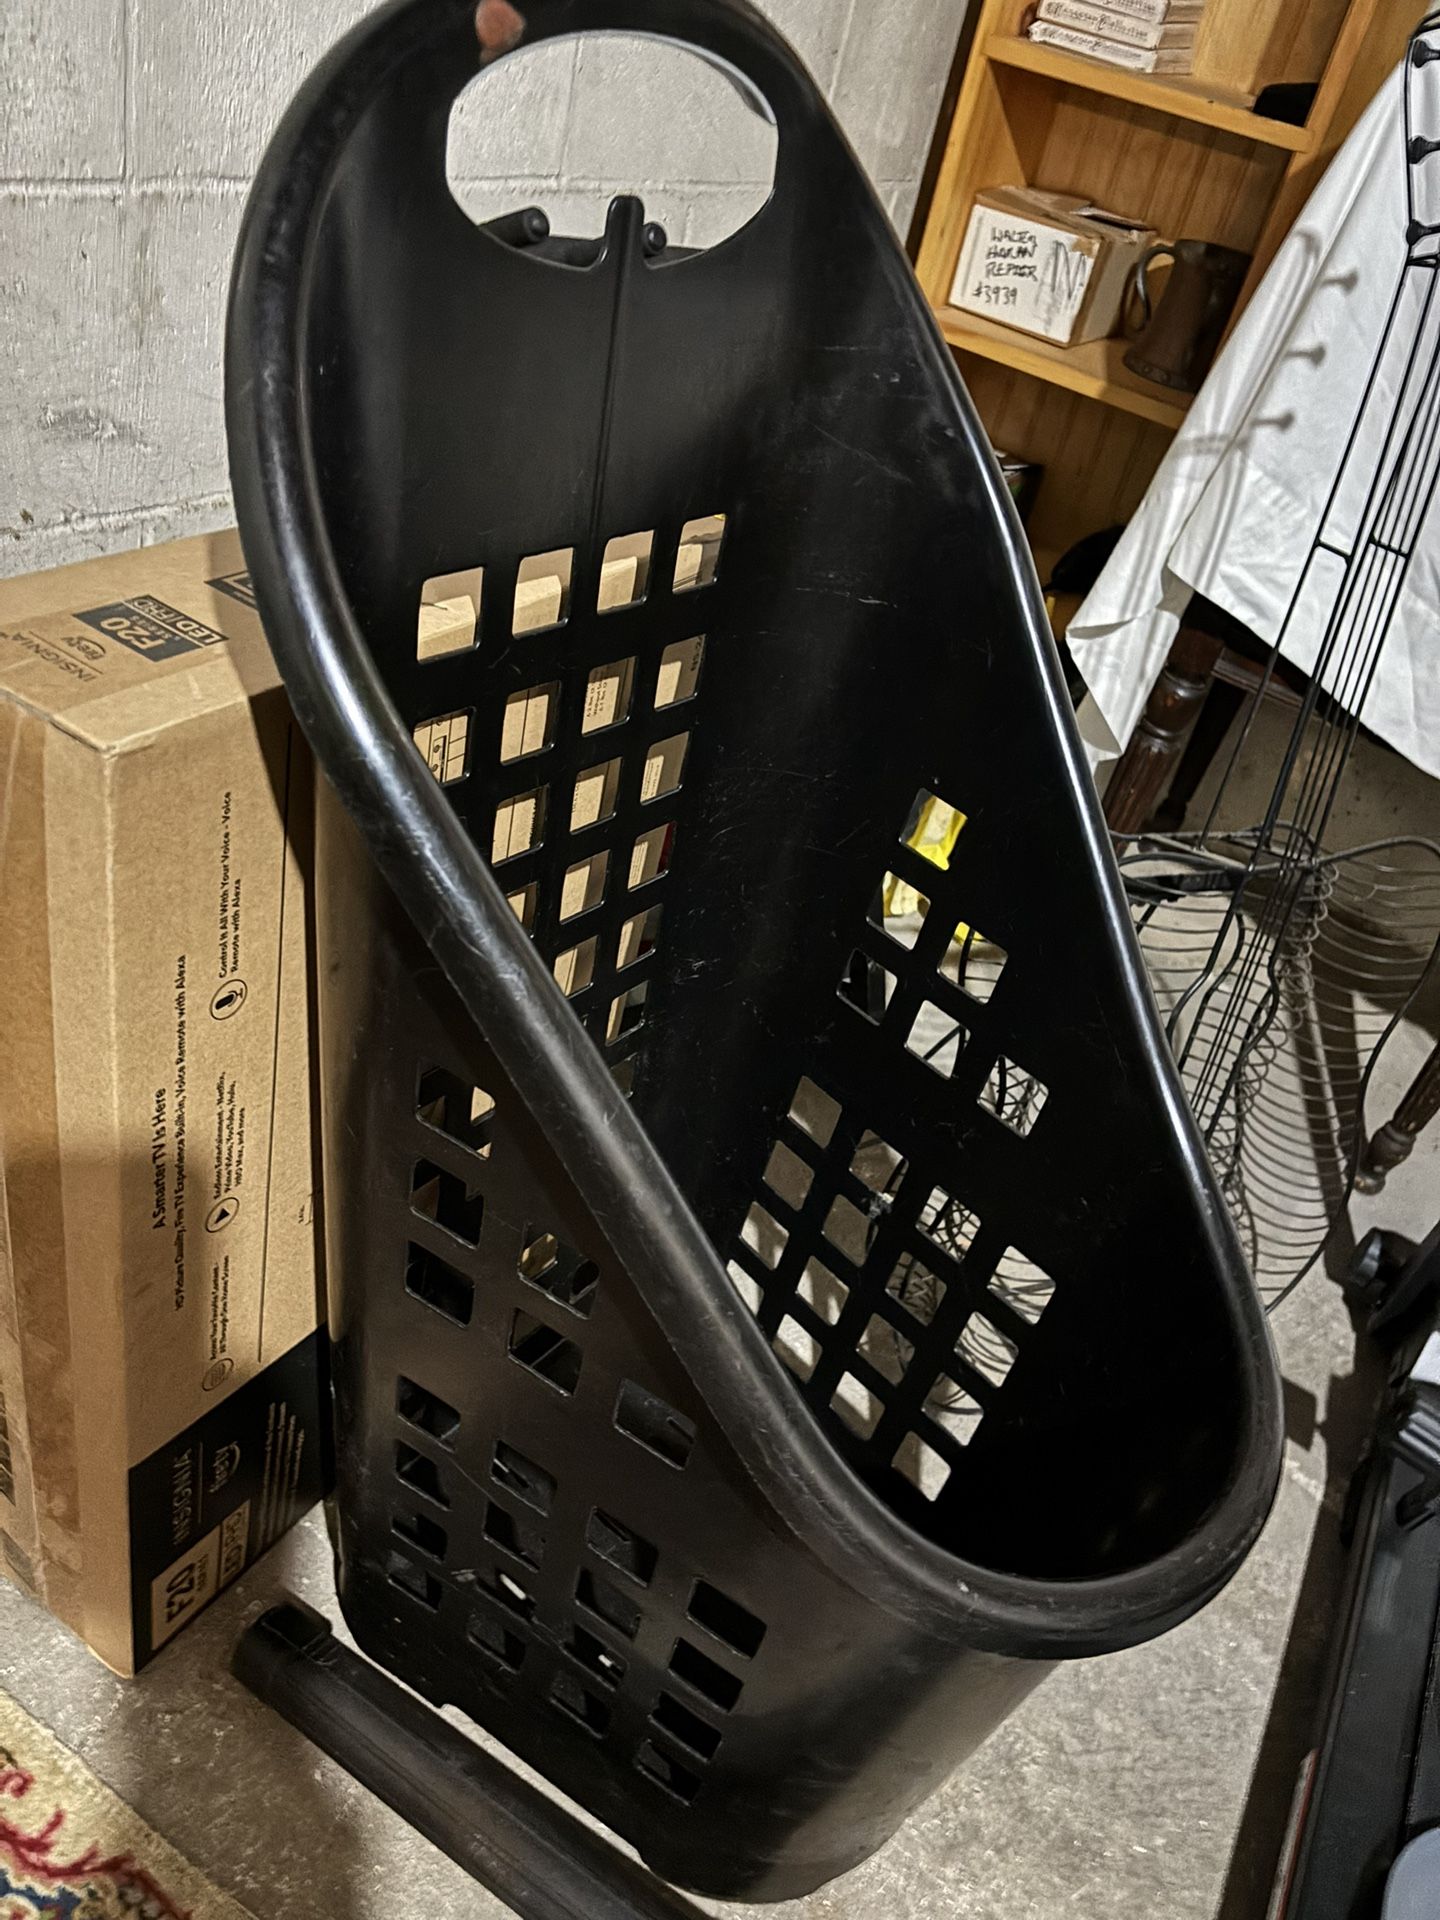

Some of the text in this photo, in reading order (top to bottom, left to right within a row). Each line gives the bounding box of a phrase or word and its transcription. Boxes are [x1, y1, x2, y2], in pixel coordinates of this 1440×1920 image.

[100, 616, 166, 650] F20
[176, 620, 222, 646] LED
[11, 632, 97, 682] INSIGNIA
[222, 792, 231, 823] Voice
[221, 832, 230, 862] Voice
[220, 864, 229, 889] Your
[220, 890, 228, 915] With
[220, 916, 228, 930] All
[231, 879, 241, 972] Remote with Alexa
[175, 955, 186, 989] Alexa
[219, 942, 228, 978] Control
[176, 991, 185, 1018] with
[176, 1020, 186, 1065] Remote
[175, 1066, 186, 1098] Voice
[175, 1095, 186, 1138] Built-in,
[152, 1088, 166, 1229] A Smarter TV Is Here
[176, 1138, 187, 1193] Experience
[175, 1195, 185, 1207] TV
[173, 1448, 192, 1545] INSIGNIA
[166, 1563, 195, 1623] F20
